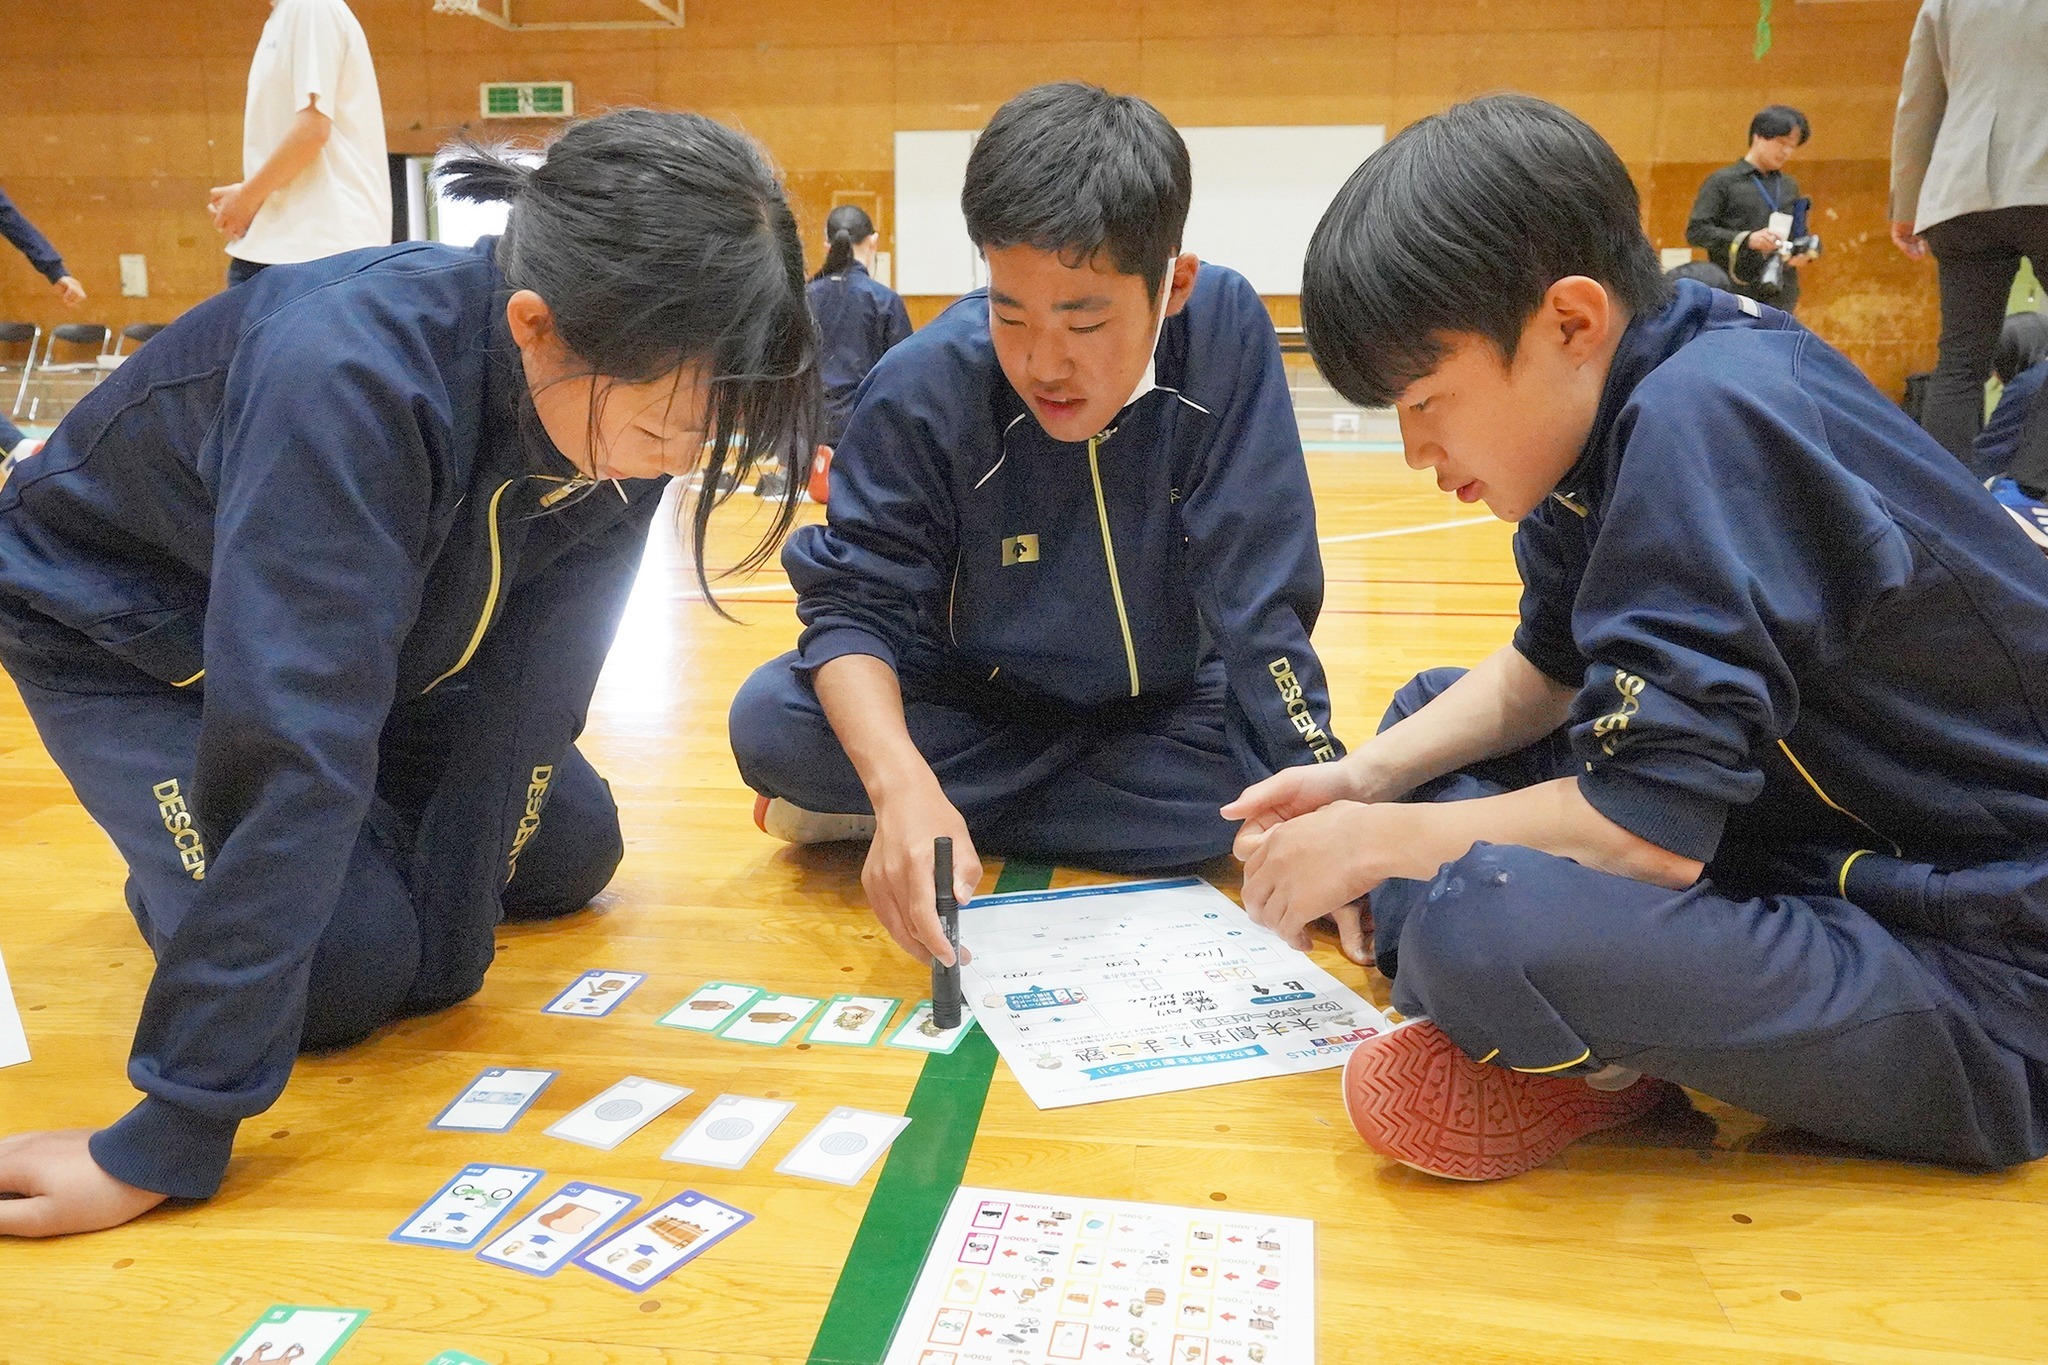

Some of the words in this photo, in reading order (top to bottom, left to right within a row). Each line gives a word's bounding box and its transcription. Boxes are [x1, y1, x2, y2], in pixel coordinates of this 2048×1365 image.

[1268, 656, 1336, 763] DESCENTE
[1074, 1018, 1320, 1062] 未来創造たまご塾
[1286, 1046, 1342, 1059] GOALS
